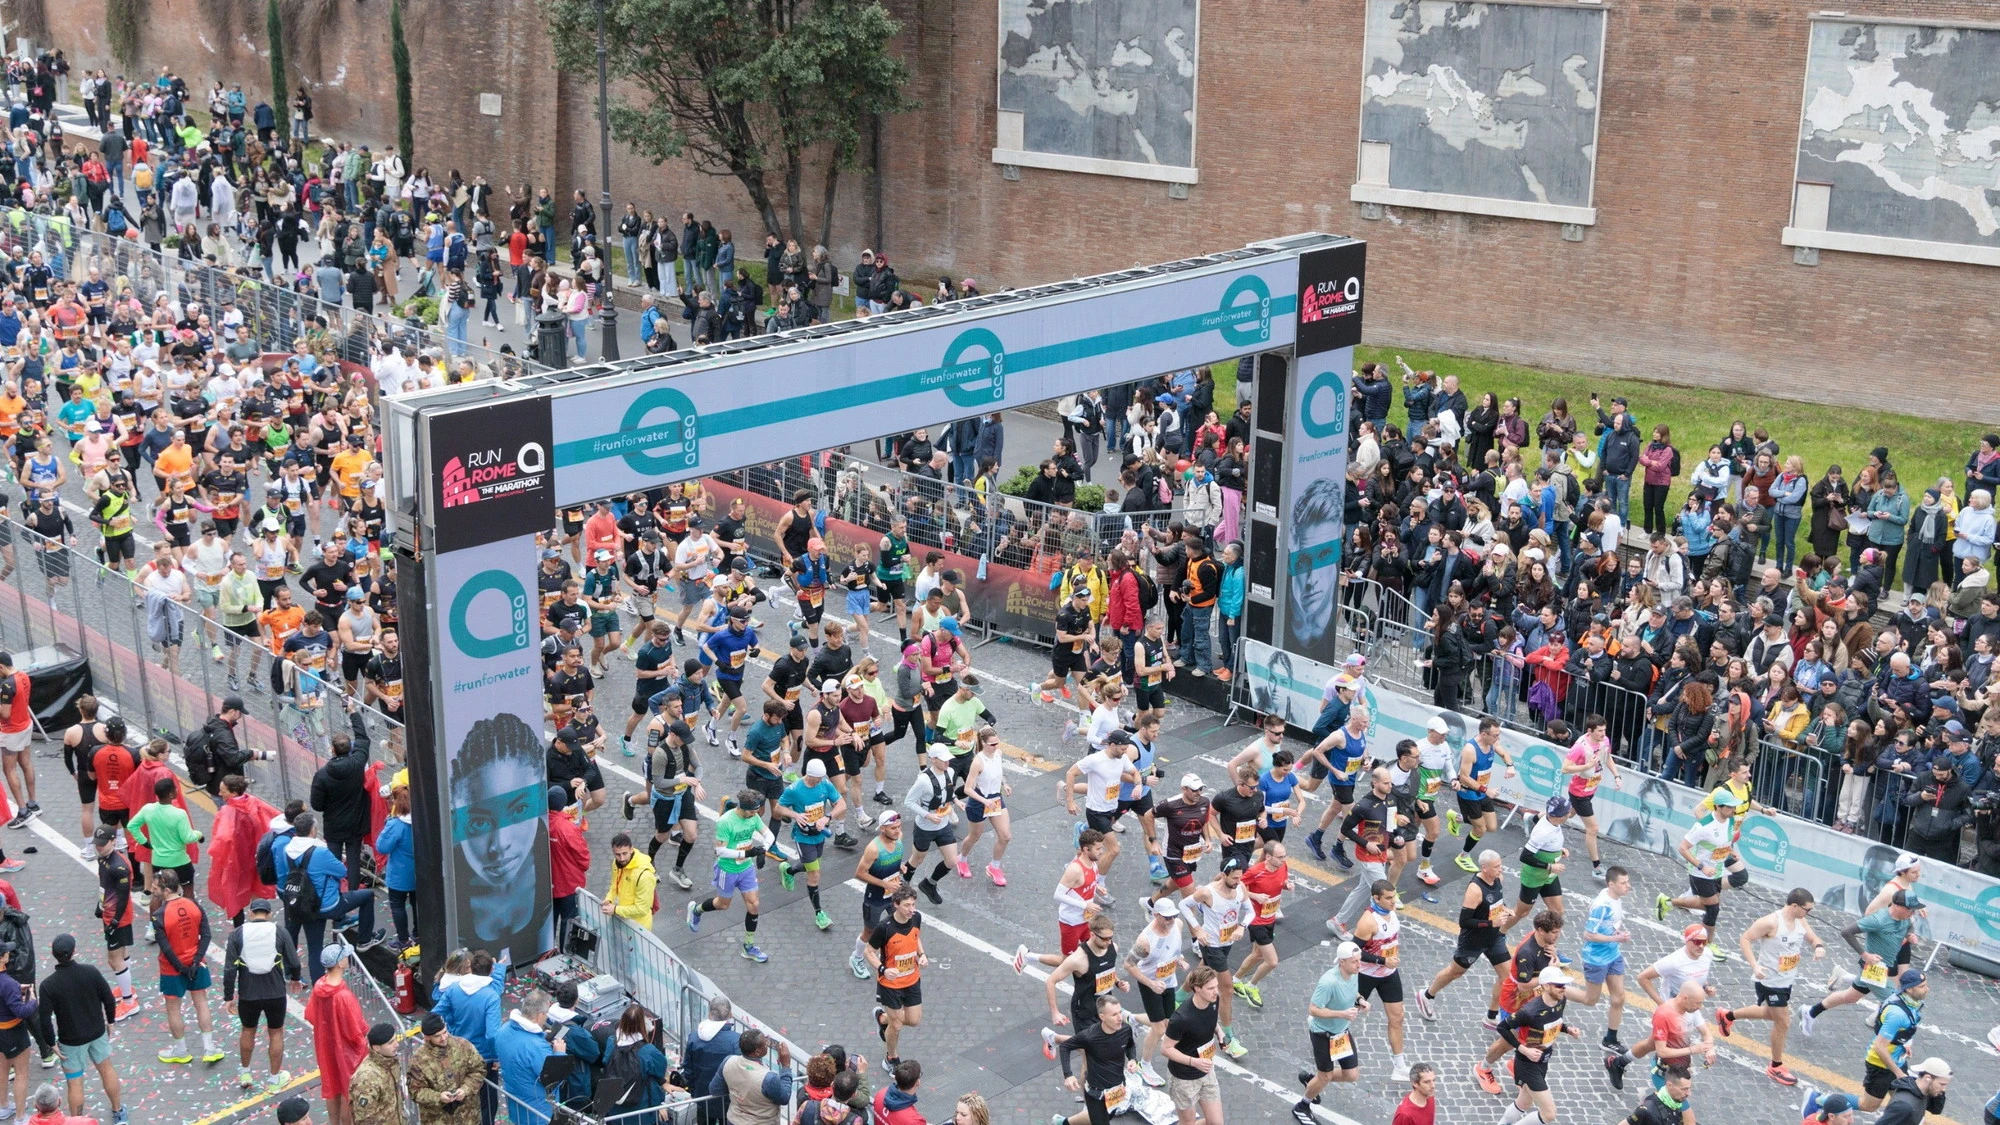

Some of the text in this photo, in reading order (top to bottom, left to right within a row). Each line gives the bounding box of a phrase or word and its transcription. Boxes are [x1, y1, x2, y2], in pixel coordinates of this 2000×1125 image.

[1317, 280, 1337, 294] RUN
[1318, 291, 1344, 306] ROME
[1330, 304, 1356, 314] MARATHON
[1201, 309, 1252, 326] #runforwater
[1260, 297, 1270, 339] acea
[920, 366, 981, 387] #runforwater
[993, 352, 1004, 398] acea
[1335, 392, 1344, 433] acea
[593, 429, 669, 453] #runforwater
[684, 414, 696, 466] acea
[468, 448, 502, 468] RUN
[1298, 446, 1342, 465] #runforwater
[472, 462, 517, 484] ROME
[481, 477, 540, 495] THE MARATHON
[1024, 585, 1045, 596] RUN
[1025, 596, 1055, 610] ROME
[514, 594, 526, 647] acea
[454, 665, 531, 693] #runforwater
[1774, 840, 1788, 872] acea
[1954, 898, 2000, 919] #runforwat
